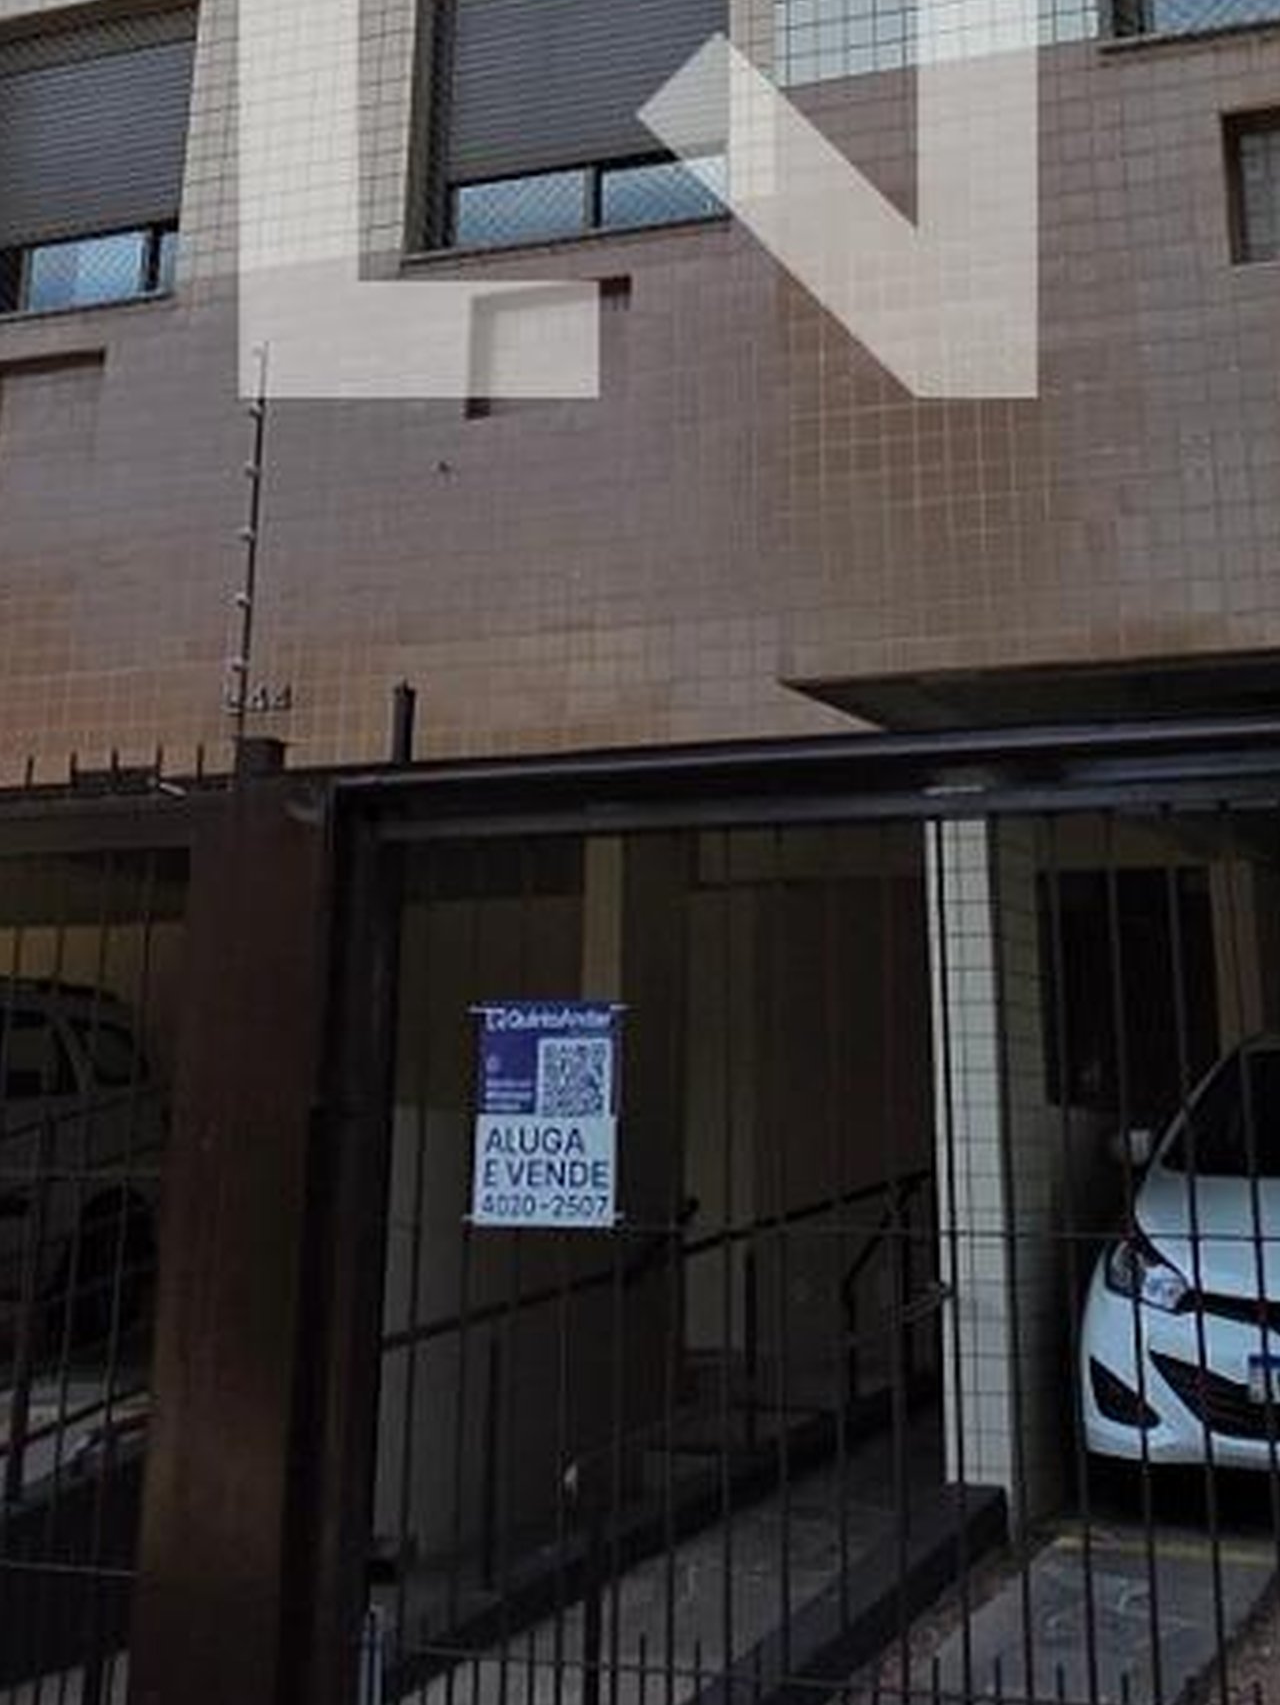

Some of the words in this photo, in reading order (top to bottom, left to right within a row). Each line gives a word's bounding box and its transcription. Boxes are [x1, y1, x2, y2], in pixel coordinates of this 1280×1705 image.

[486, 1127, 585, 1155] ALUGA
[484, 1159, 498, 1187] E
[506, 1159, 609, 1188] VENDE
[483, 1193, 608, 1217] 4020-2507
